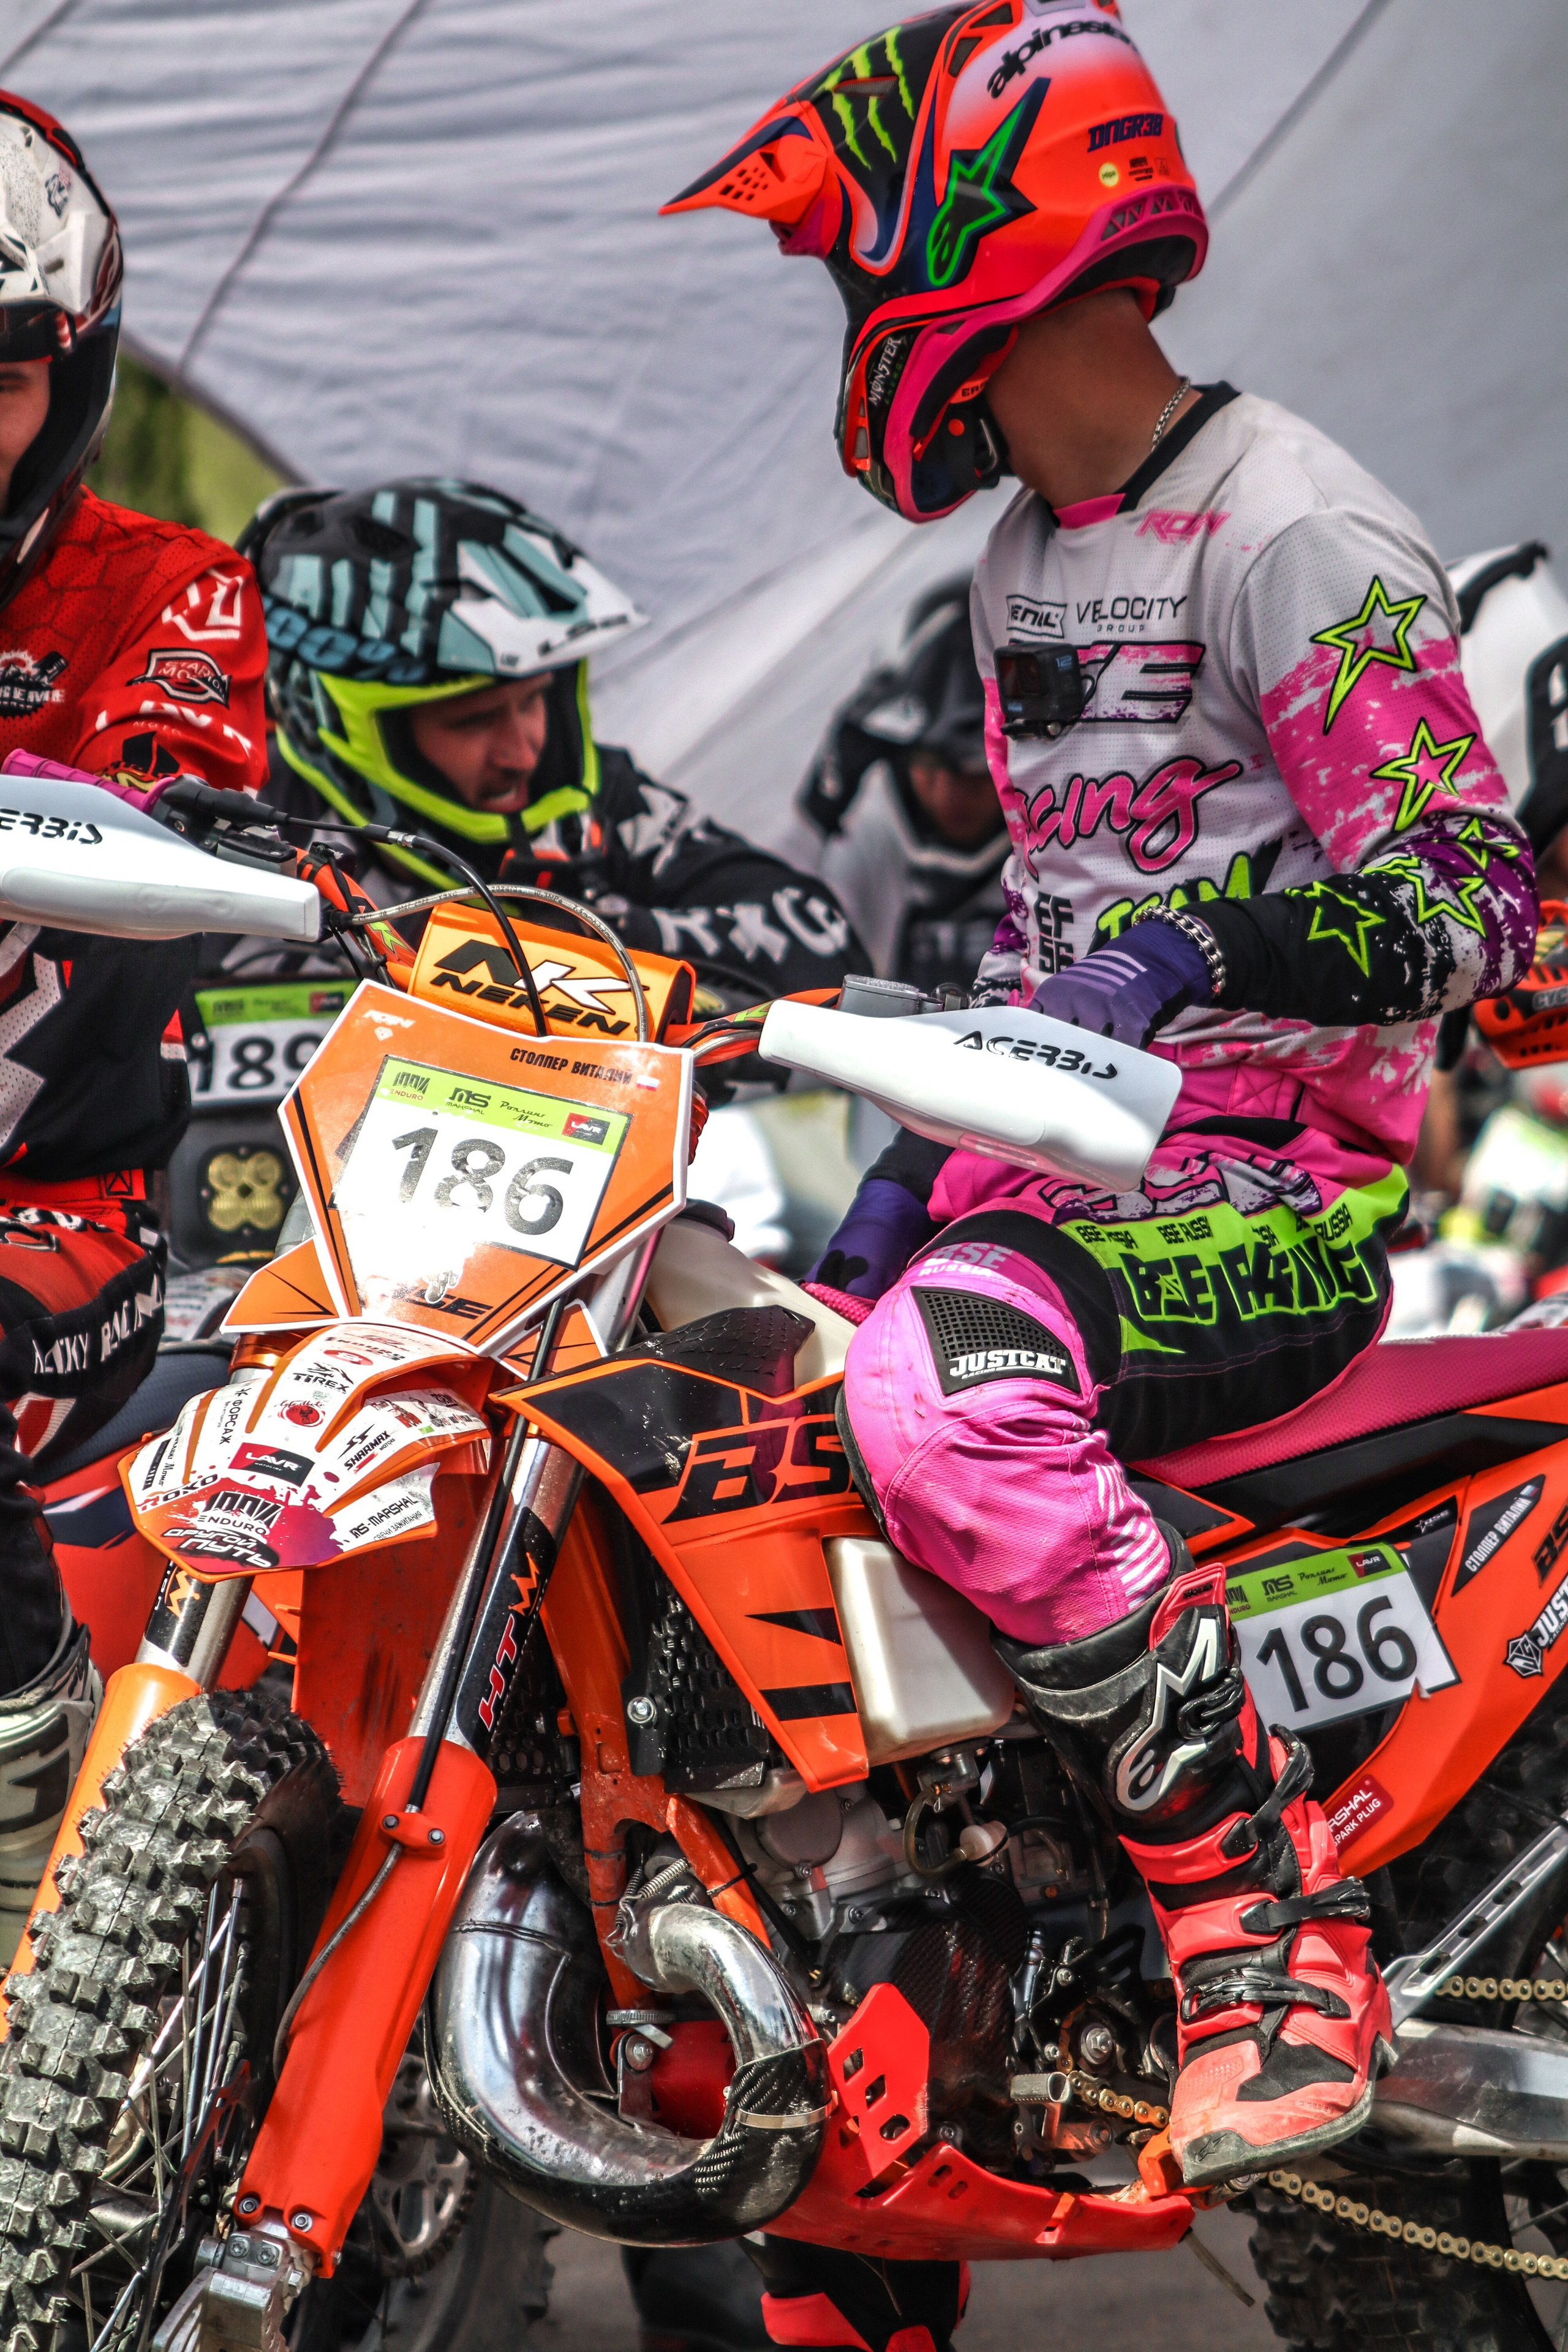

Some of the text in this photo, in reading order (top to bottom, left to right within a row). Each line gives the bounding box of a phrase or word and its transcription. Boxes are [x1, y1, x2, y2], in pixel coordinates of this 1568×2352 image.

[1077, 595, 1187, 624] VELOCITY
[430, 971, 630, 1035] NEKEN
[510, 1048, 568, 1071] СТОЛПЕР
[571, 1121, 601, 1134] LAVR
[391, 1126, 574, 1235] 186
[1156, 1223, 1185, 1245] BSE
[1314, 1202, 1354, 1242] RUSSIA
[949, 1349, 1066, 1377] JUSTCAT
[219, 1400, 243, 1445] ФОРСАЖ
[246, 1452, 298, 1471] LAVR
[344, 1431, 391, 1471] SHARMAX
[660, 1421, 861, 1525] BS
[197, 1515, 268, 1535] ENDURO
[1464, 1496, 1531, 1572] СТОЛПЕР ВИТАЛИЙ
[163, 1529, 257, 1550] ДРУГОЙ
[179, 1539, 271, 1567] ПУТЬ
[1356, 1556, 1381, 1567] LAVR
[1229, 1604, 1251, 1615] NDURO
[1256, 1595, 1417, 1713] 186
[1327, 1789, 1373, 1832] RSHAL
[1356, 1798, 1381, 1823] PLUG
